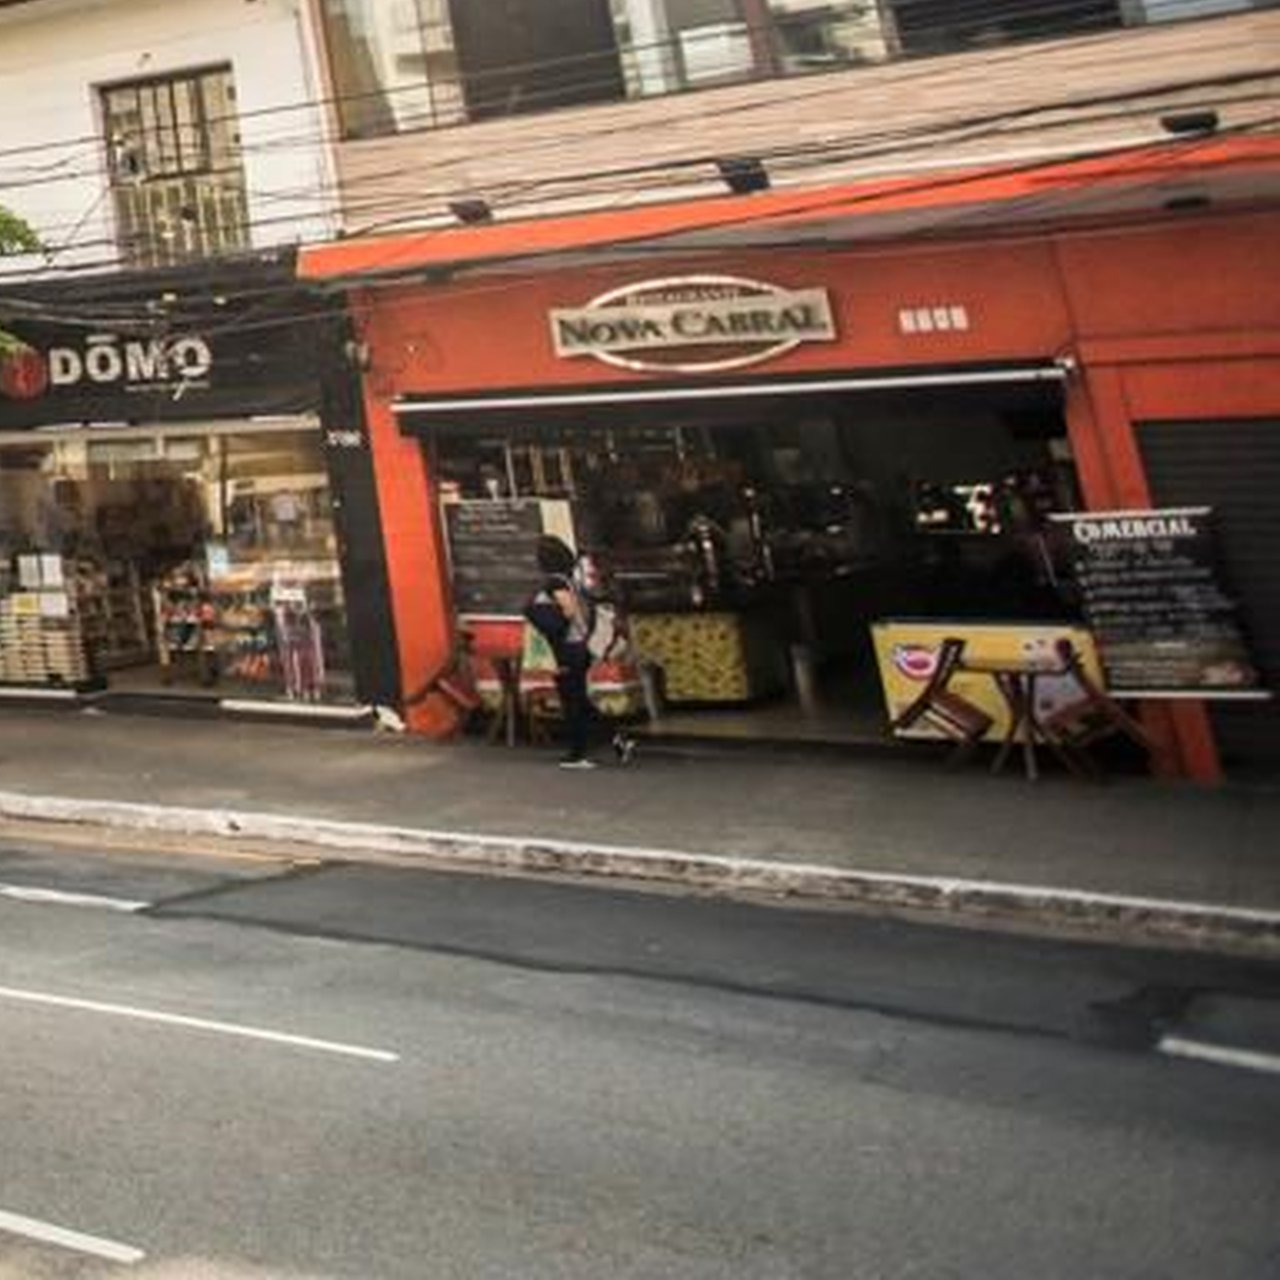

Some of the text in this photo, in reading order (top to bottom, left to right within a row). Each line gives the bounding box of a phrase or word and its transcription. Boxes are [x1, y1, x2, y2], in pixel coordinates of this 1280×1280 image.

[557, 303, 827, 349] NOVA CABRAL
[1073, 518, 1197, 544] COMERCIAL
